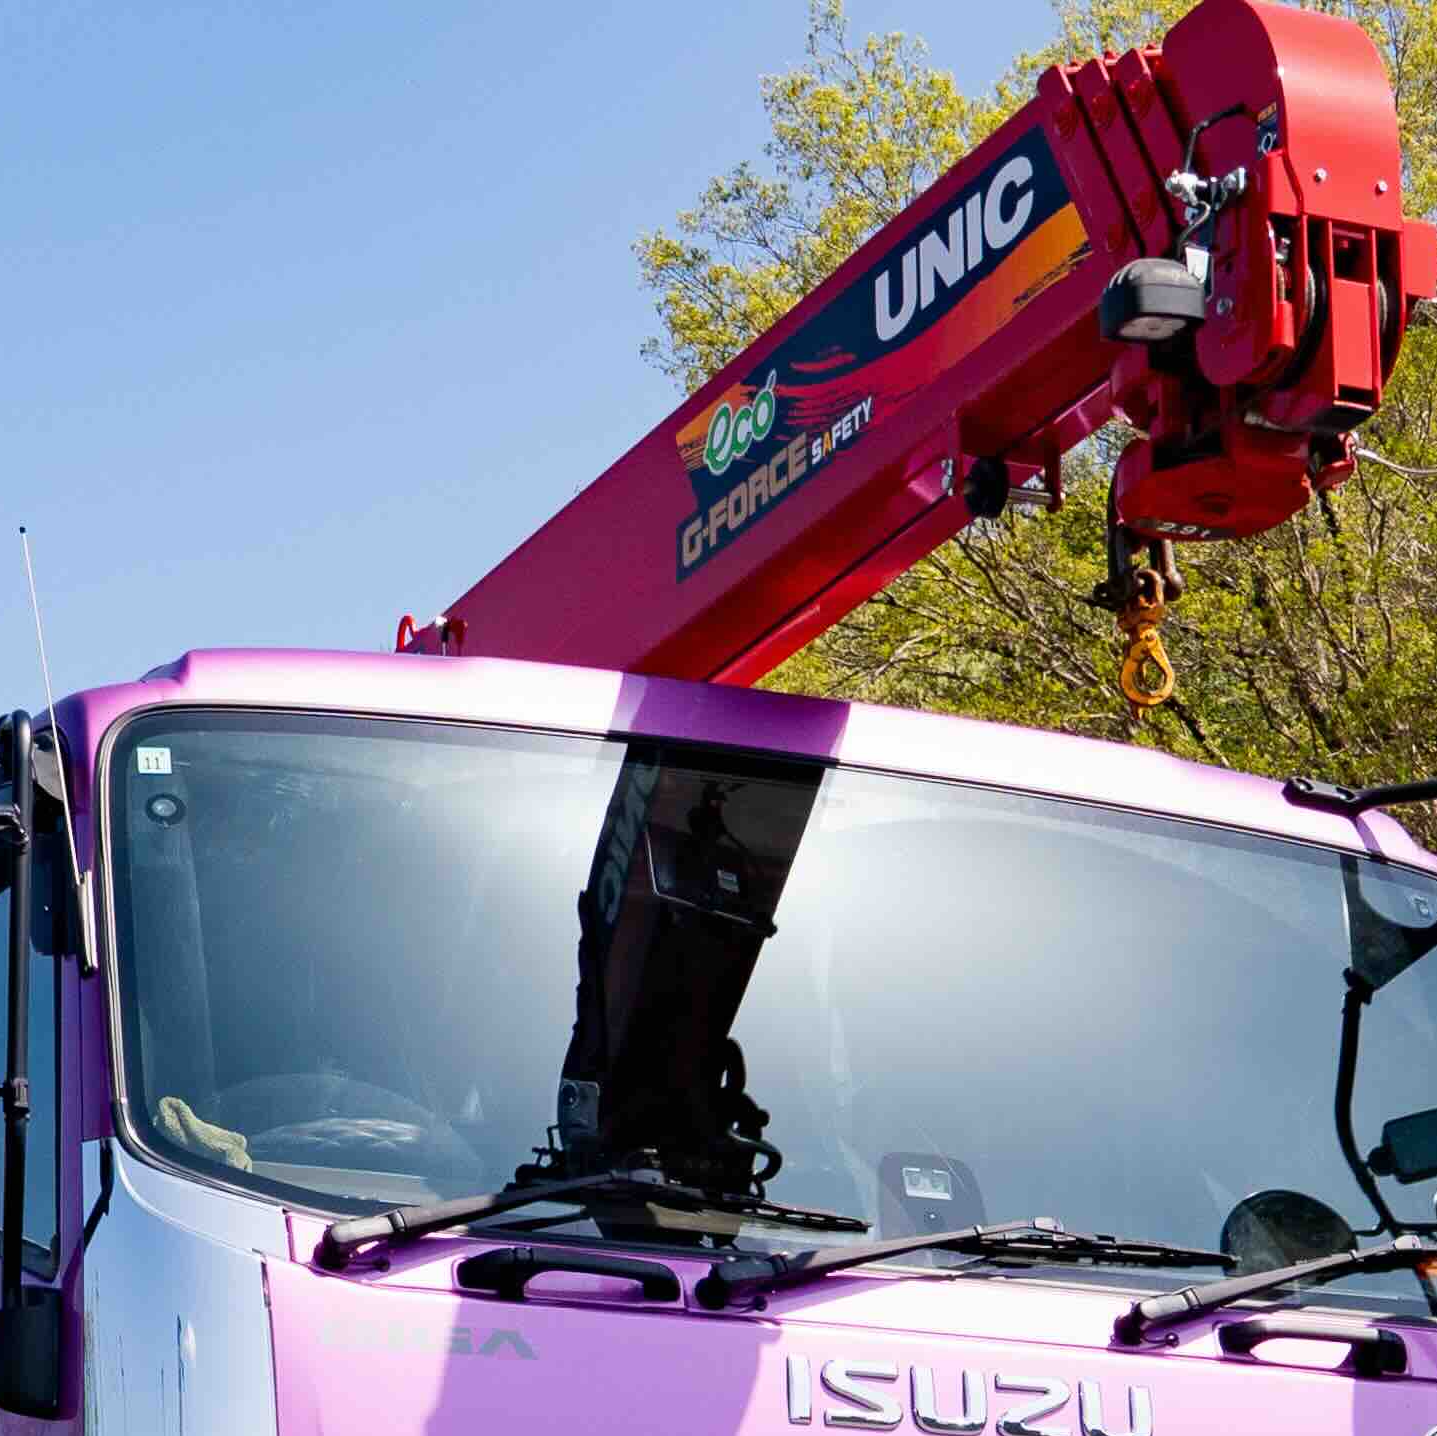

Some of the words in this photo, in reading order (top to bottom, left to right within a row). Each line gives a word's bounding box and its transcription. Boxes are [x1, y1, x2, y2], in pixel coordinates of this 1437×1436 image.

[875, 155, 1034, 342] UNIC
[703, 368, 777, 476] eco
[811, 395, 875, 465] SAFETY
